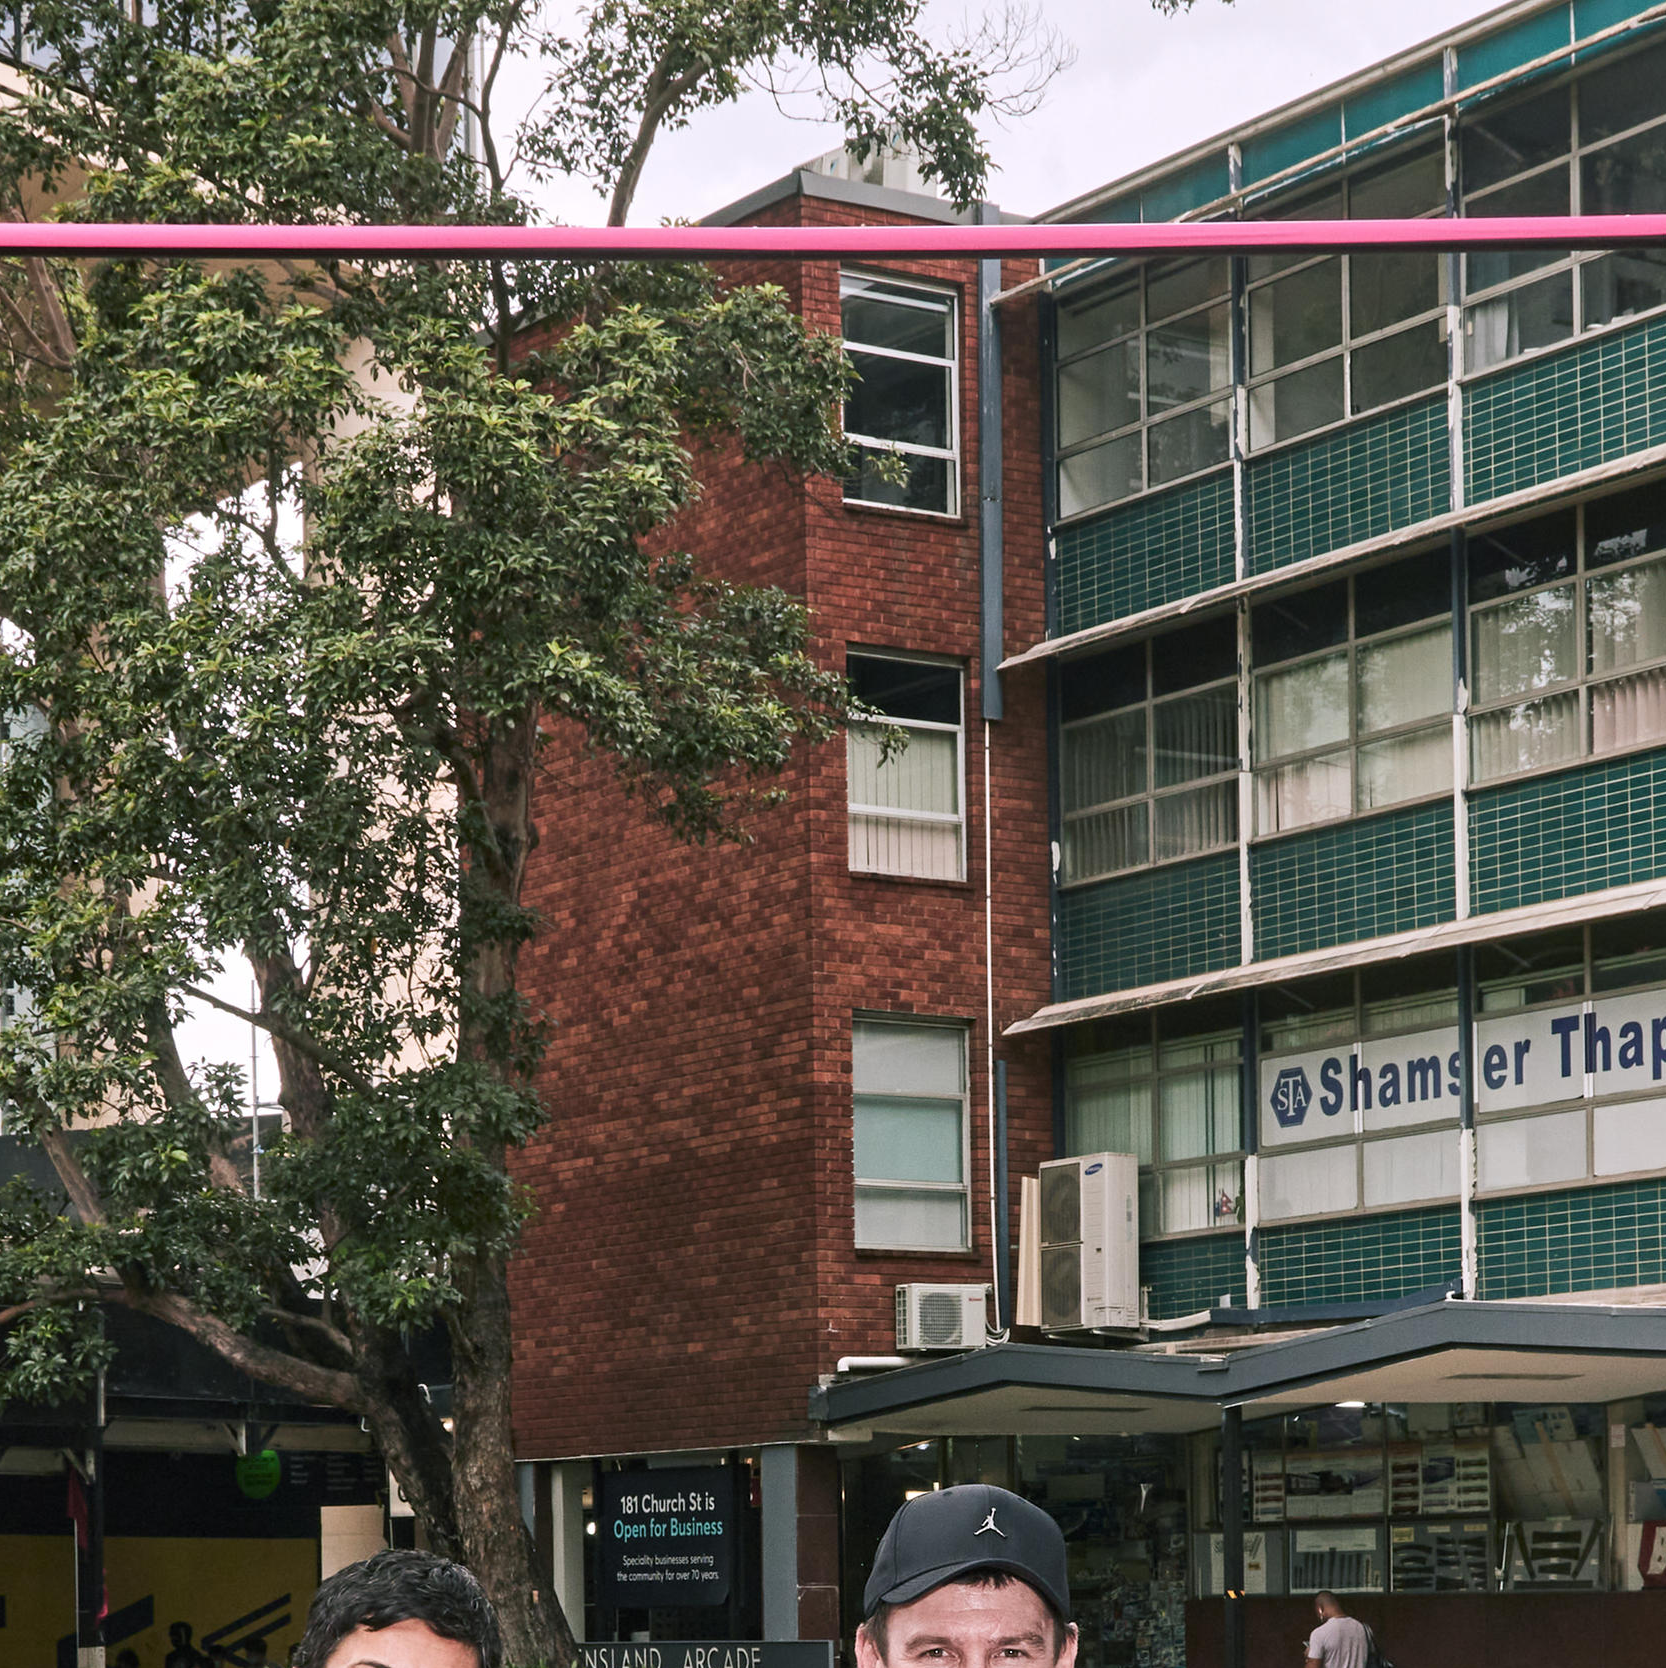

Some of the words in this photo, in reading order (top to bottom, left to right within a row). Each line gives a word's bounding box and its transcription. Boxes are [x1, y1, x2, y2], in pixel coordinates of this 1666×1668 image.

[1319, 1038, 1531, 1117] Shamser
[620, 1495, 638, 1515] 181
[641, 1492, 686, 1513] Church
[689, 1492, 702, 1512] St
[705, 1491, 716, 1511] is
[613, 1519, 647, 1543] Open
[650, 1517, 668, 1537] for
[670, 1517, 724, 1537] Business
[622, 1554, 654, 1568] Speciality
[655, 1554, 689, 1565] businesses
[690, 1553, 715, 1567] serving
[617, 1571, 628, 1582] the
[628, 1570, 665, 1584] community
[665, 1569, 675, 1581] for
[676, 1572, 690, 1581] over
[691, 1569, 699, 1581] 70
